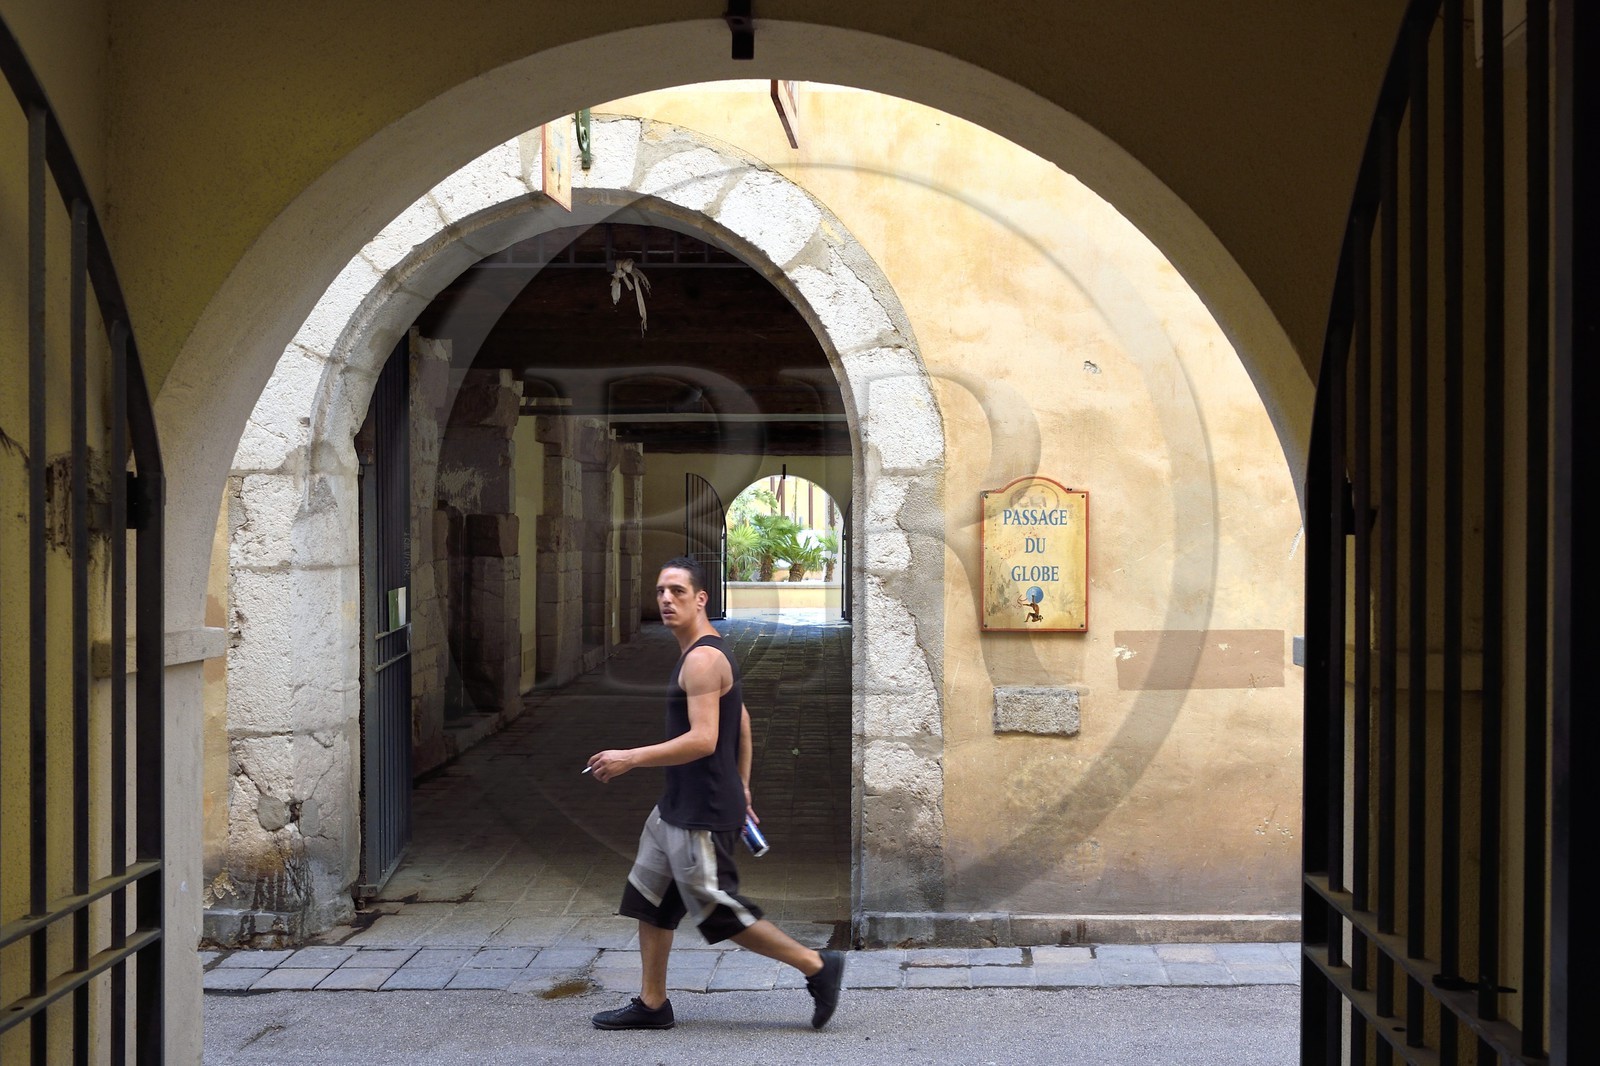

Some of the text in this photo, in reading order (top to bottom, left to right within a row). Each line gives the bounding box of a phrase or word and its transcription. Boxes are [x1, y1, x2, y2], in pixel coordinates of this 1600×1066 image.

[1003, 509, 1067, 525] PASSAGE
[1024, 537, 1046, 553] DU
[1011, 565, 1059, 582] GLOBE
